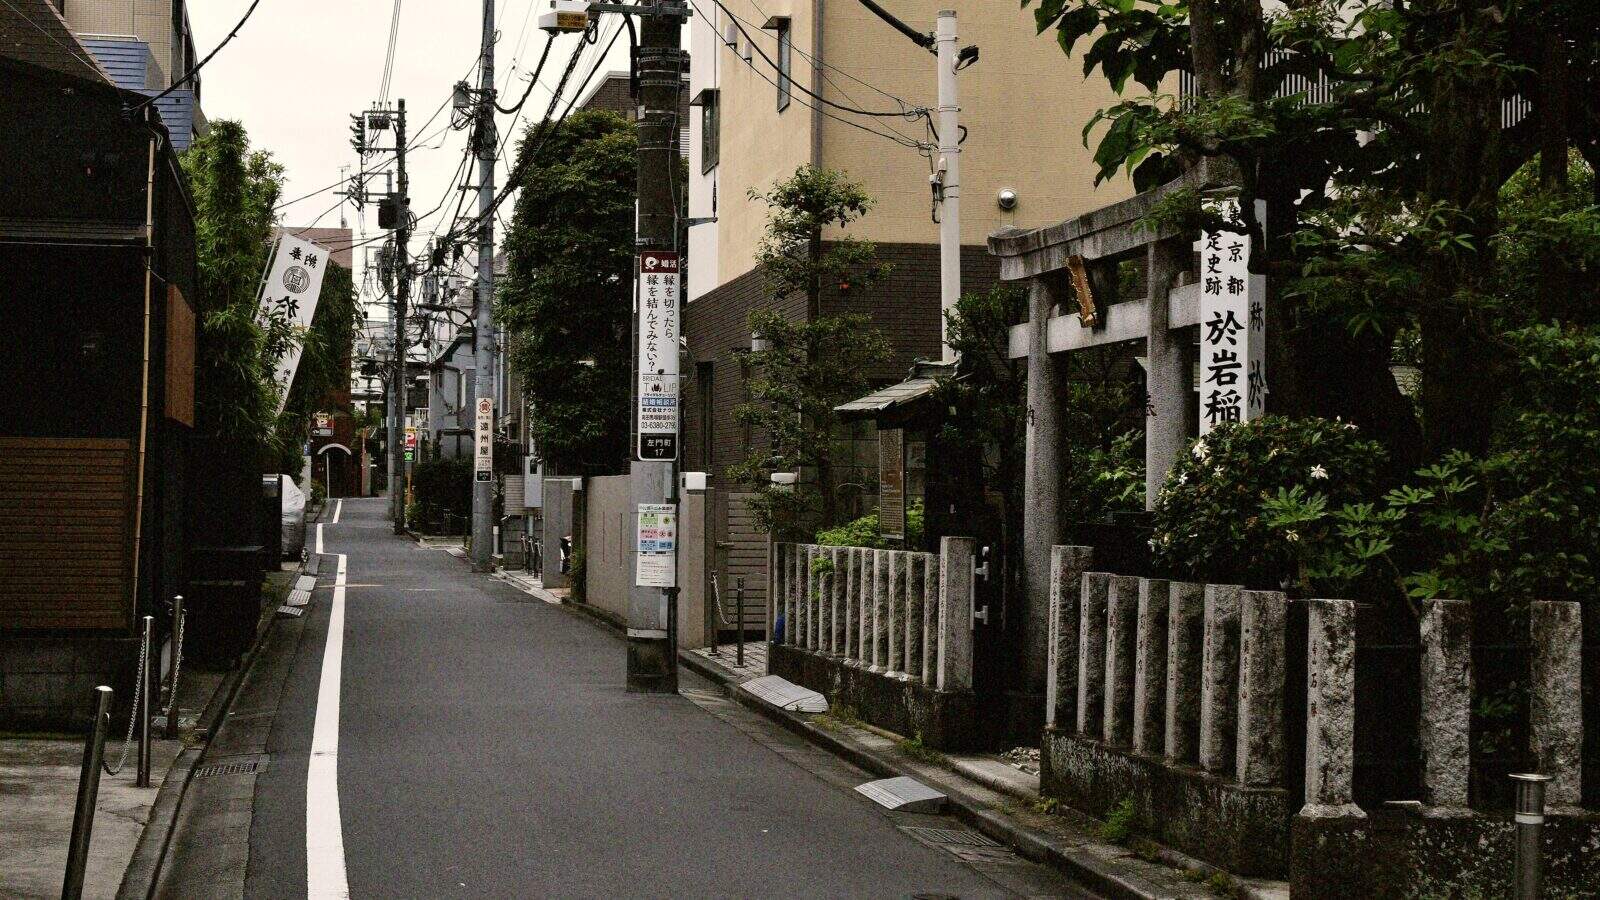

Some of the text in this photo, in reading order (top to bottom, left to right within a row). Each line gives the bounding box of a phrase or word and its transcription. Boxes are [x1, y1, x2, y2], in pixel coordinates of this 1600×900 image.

[663, 274, 675, 344] 縁を切ったら、
[646, 438, 672, 448] 左門町
[654, 448, 665, 457] 17
